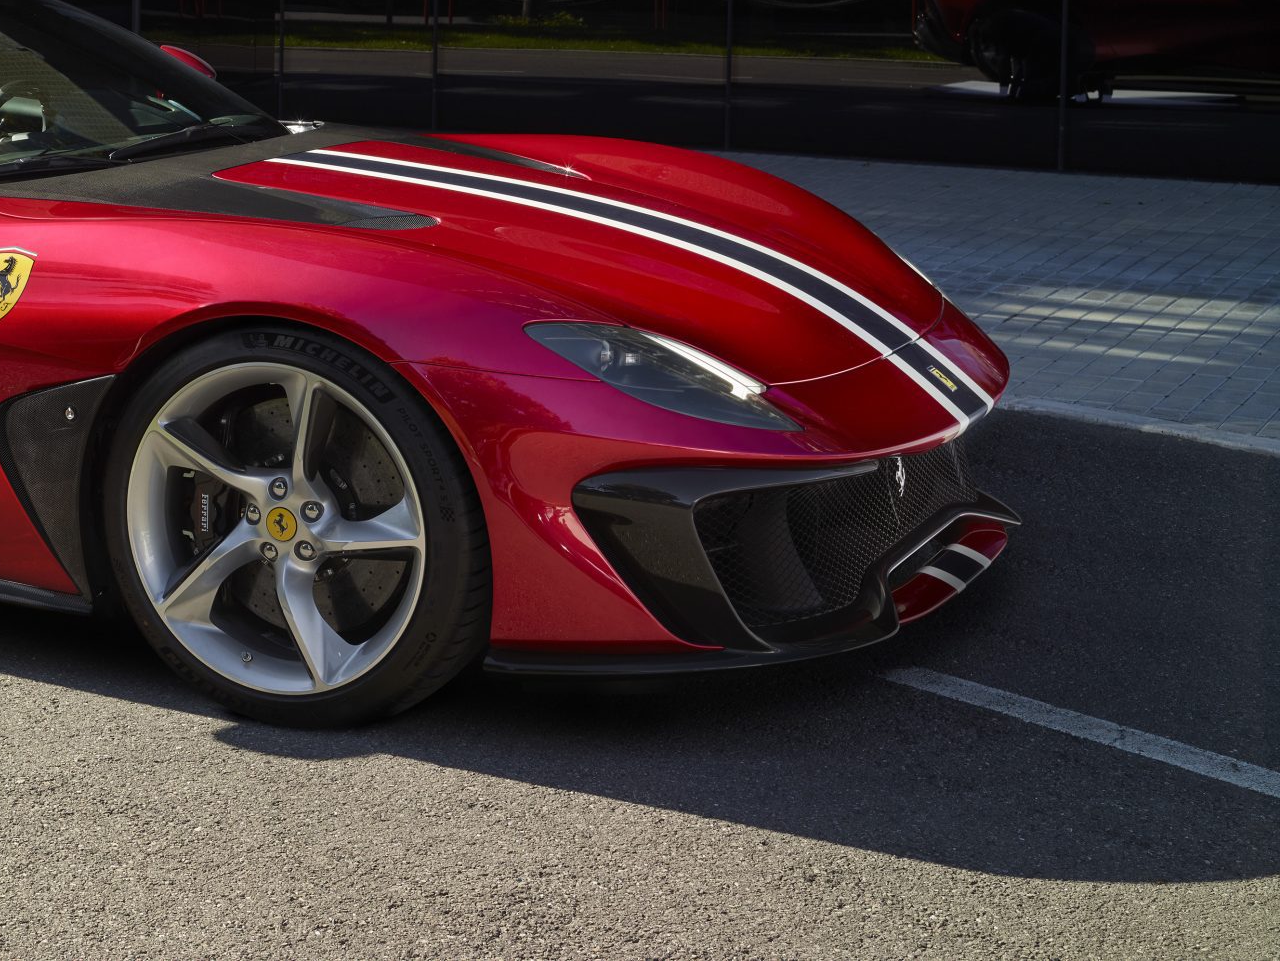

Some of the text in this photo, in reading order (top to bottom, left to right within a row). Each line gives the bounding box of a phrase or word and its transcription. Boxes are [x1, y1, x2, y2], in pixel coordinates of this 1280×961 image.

[0, 302, 12, 312] T
[272, 334, 391, 400] MICHELIN
[397, 407, 424, 438] PILOT
[420, 442, 444, 484] SPORT
